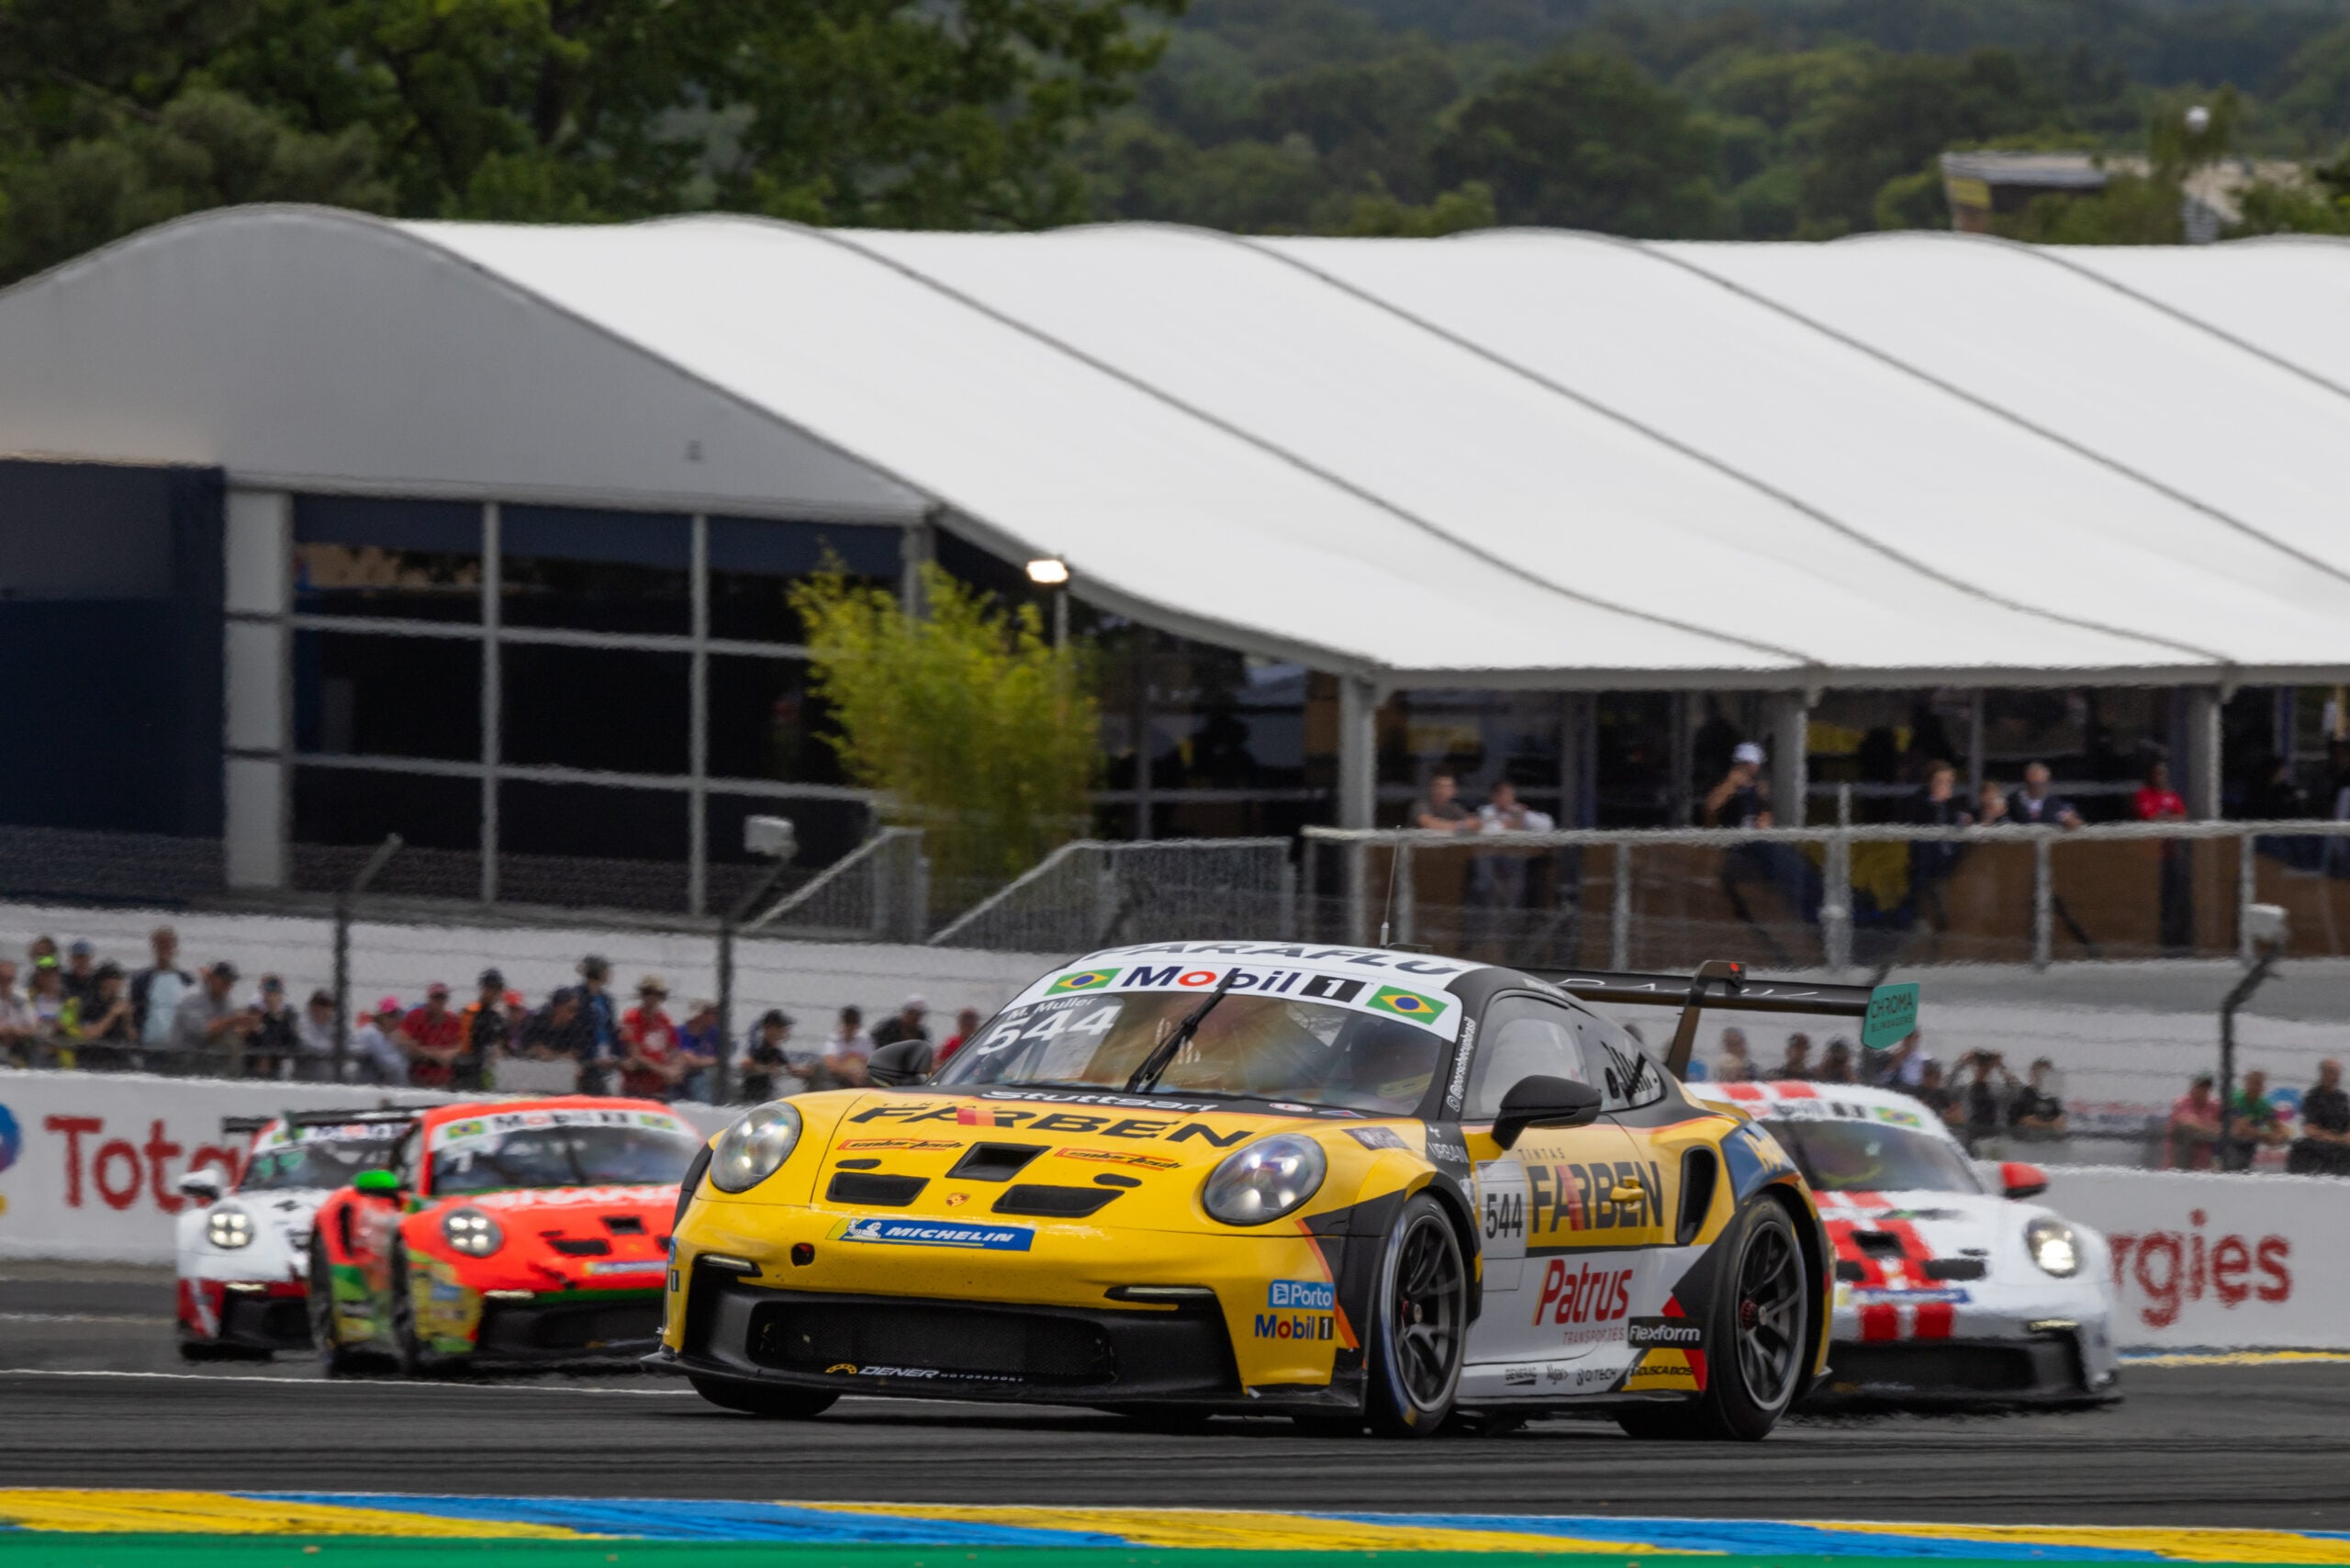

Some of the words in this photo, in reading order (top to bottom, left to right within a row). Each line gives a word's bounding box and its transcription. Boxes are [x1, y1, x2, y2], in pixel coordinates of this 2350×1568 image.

[1081, 942, 1462, 975] PARAFLU
[1121, 966, 1302, 993] Mobil
[1871, 991, 1914, 1019] CHROMA
[977, 1005, 1123, 1056] 544
[981, 1091, 1219, 1112] Stuttgart
[848, 1105, 1256, 1148] FARBEN
[1427, 1142, 1471, 1164] URBAN
[1517, 1148, 1566, 1161] TINTAS
[1527, 1161, 1664, 1234] FARBEN
[1485, 1193, 1523, 1239] 544
[885, 1226, 1015, 1243] MICHELIN
[1291, 1283, 1332, 1307] Porto
[1532, 1259, 1633, 1327] Patrus
[1254, 1314, 1315, 1339] Mobil
[1628, 1325, 1701, 1342] Flexform
[858, 1365, 940, 1379] DENER
[940, 1372, 1024, 1383] MOTORSPORT
